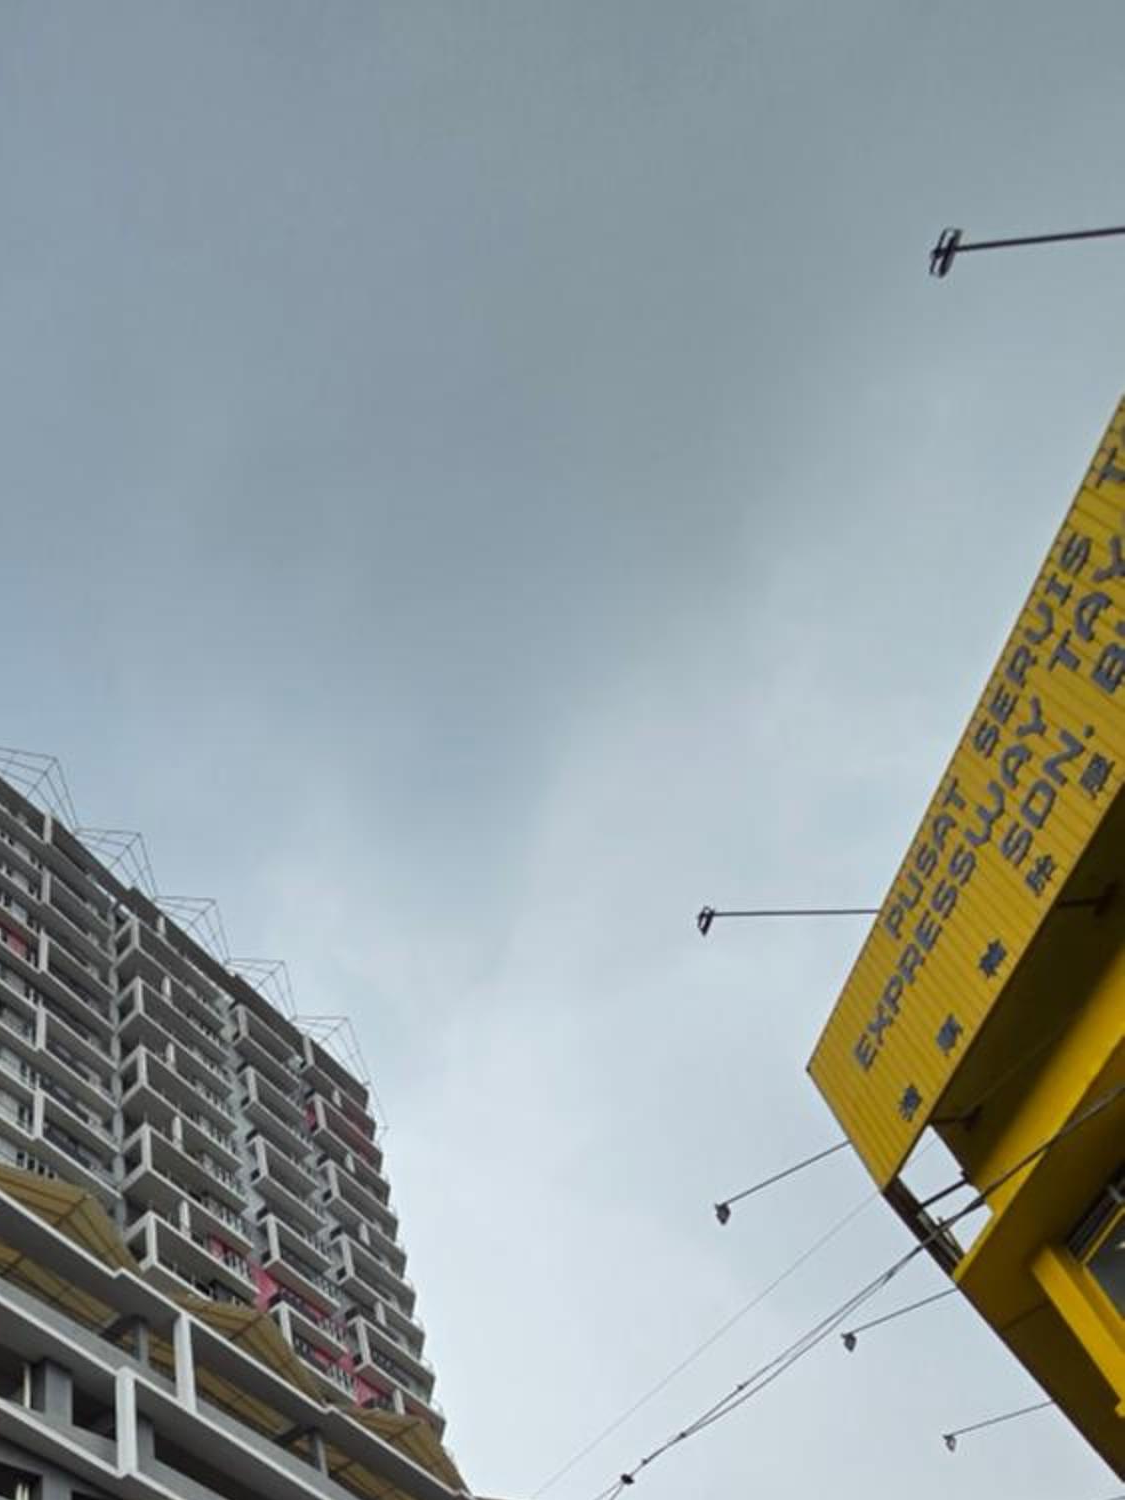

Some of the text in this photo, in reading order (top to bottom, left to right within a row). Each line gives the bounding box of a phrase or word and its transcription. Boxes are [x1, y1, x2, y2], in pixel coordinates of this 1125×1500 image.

[852, 695, 1047, 1071] EXPRESSWAY
[883, 777, 967, 940] PUSAT
[972, 533, 1092, 760] SERVIS
[999, 724, 1095, 869] SDN.
